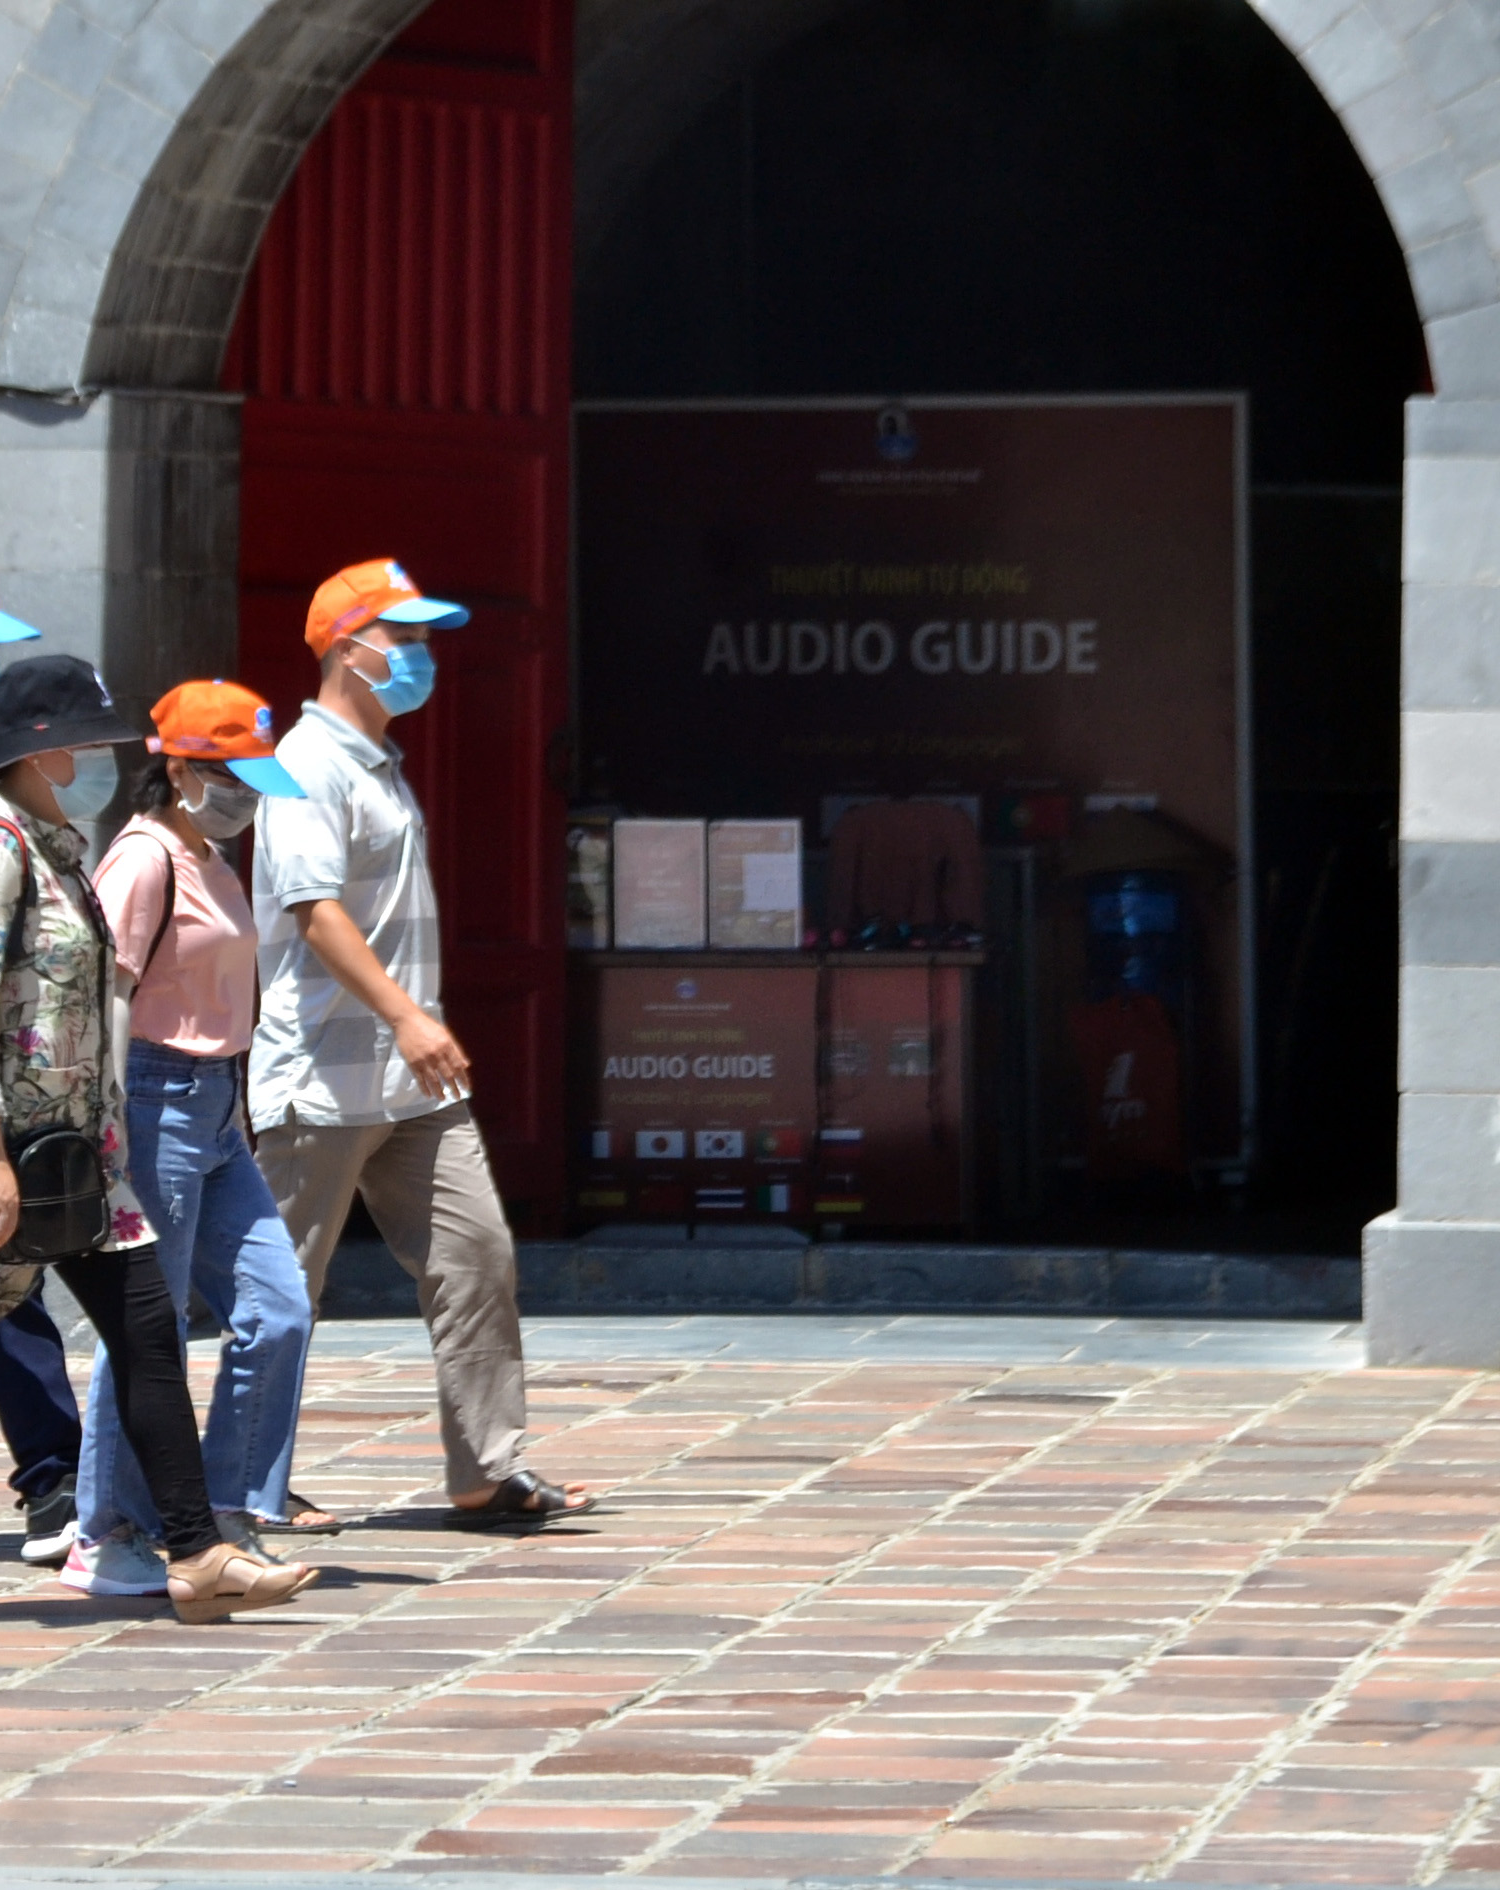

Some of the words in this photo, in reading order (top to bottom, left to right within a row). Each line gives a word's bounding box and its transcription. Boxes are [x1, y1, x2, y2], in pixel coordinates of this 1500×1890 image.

[703, 619, 897, 676] AUDIO
[909, 619, 1100, 676] GUIDE
[603, 1055, 687, 1079] AUDIO
[691, 1055, 774, 1079] GUIDE
